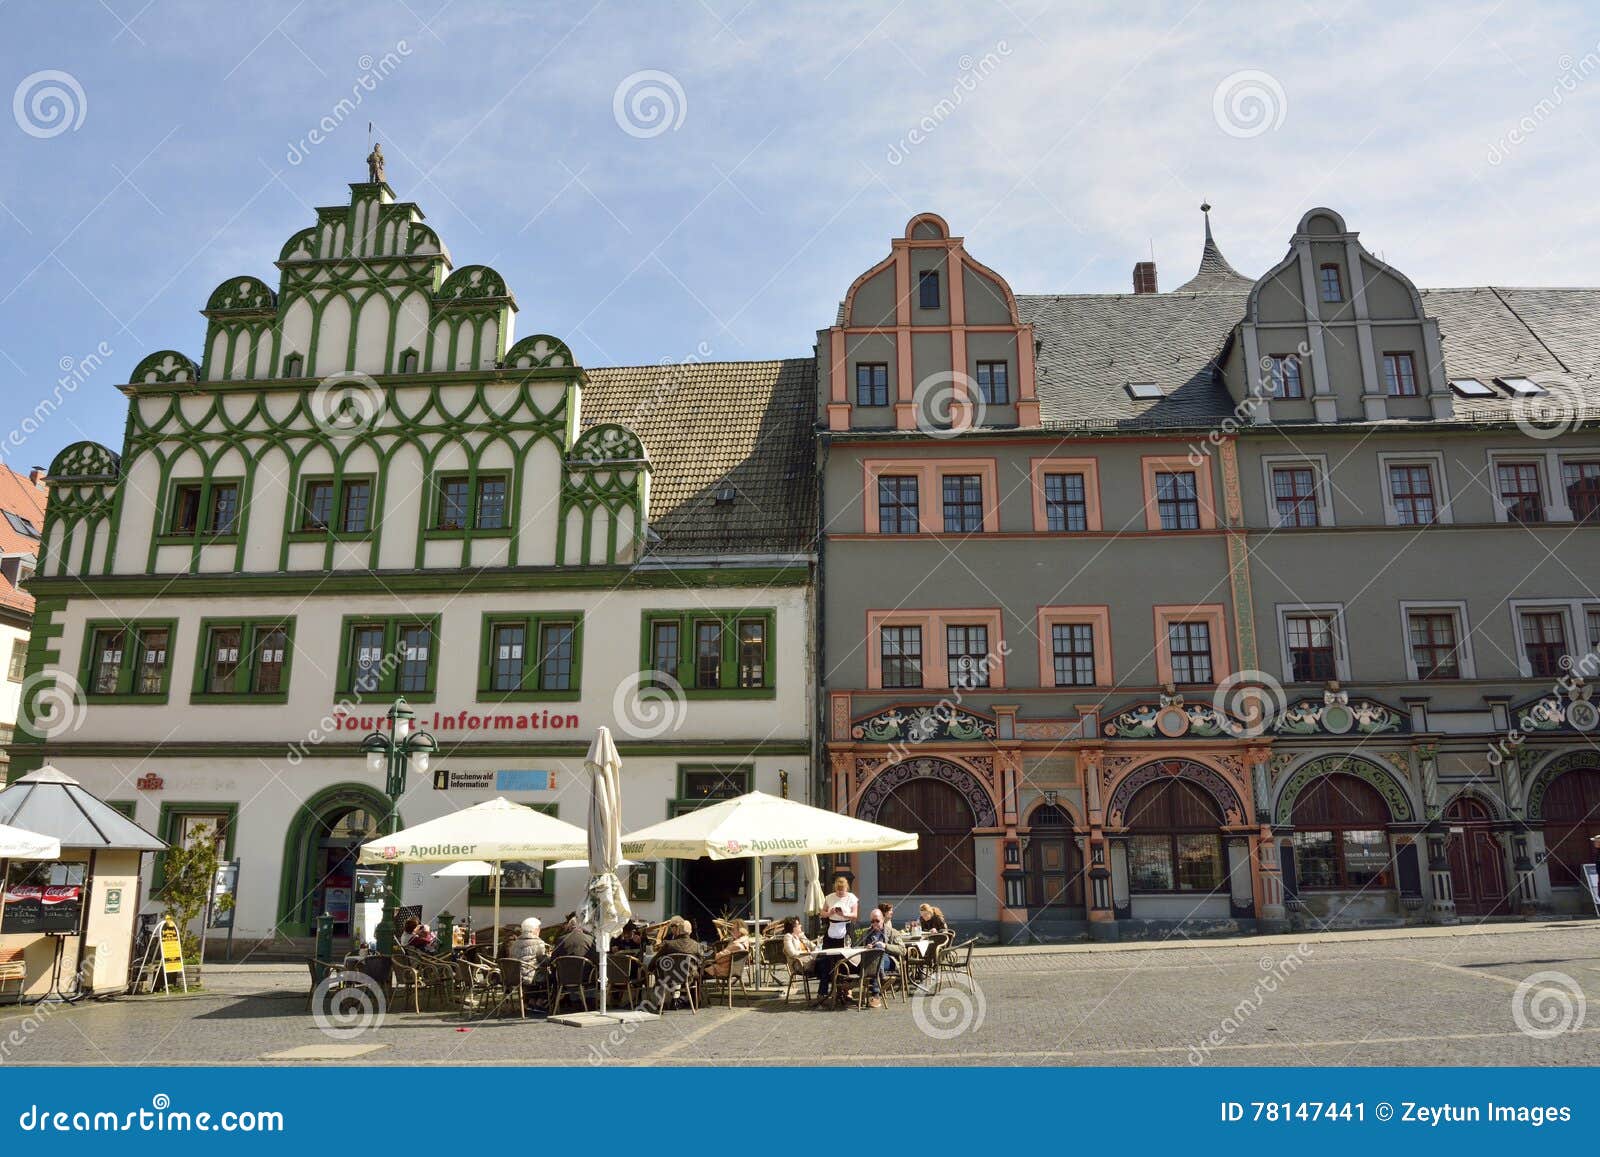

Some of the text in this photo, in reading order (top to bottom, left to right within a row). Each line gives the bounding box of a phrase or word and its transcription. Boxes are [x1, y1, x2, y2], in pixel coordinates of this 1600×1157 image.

[451, 772, 494, 780] Buchenwald
[450, 780, 489, 788] Information
[751, 838, 809, 852] Apoldaer
[409, 844, 478, 857] Apoldaer
